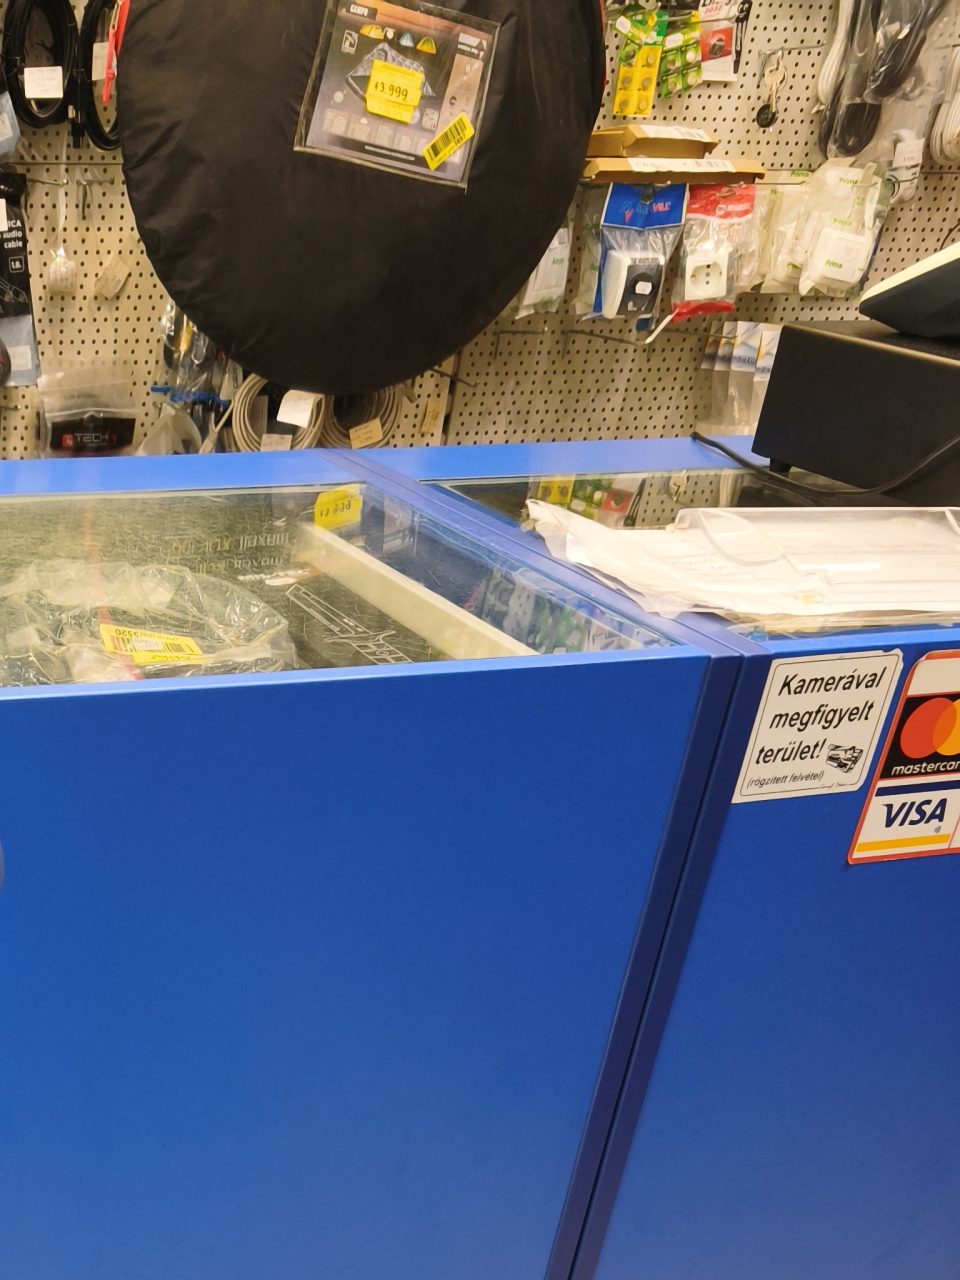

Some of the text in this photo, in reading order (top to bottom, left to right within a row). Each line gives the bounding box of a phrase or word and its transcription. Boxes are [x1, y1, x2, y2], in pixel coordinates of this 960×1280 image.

[2, 229, 22, 239] audio
[3, 240, 23, 249] cable
[778, 666, 887, 696] Kamerával
[769, 700, 875, 732] megfigyelt
[755, 738, 827, 765] terület!
[891, 760, 960, 776] mastercar
[882, 798, 948, 828] VISA
